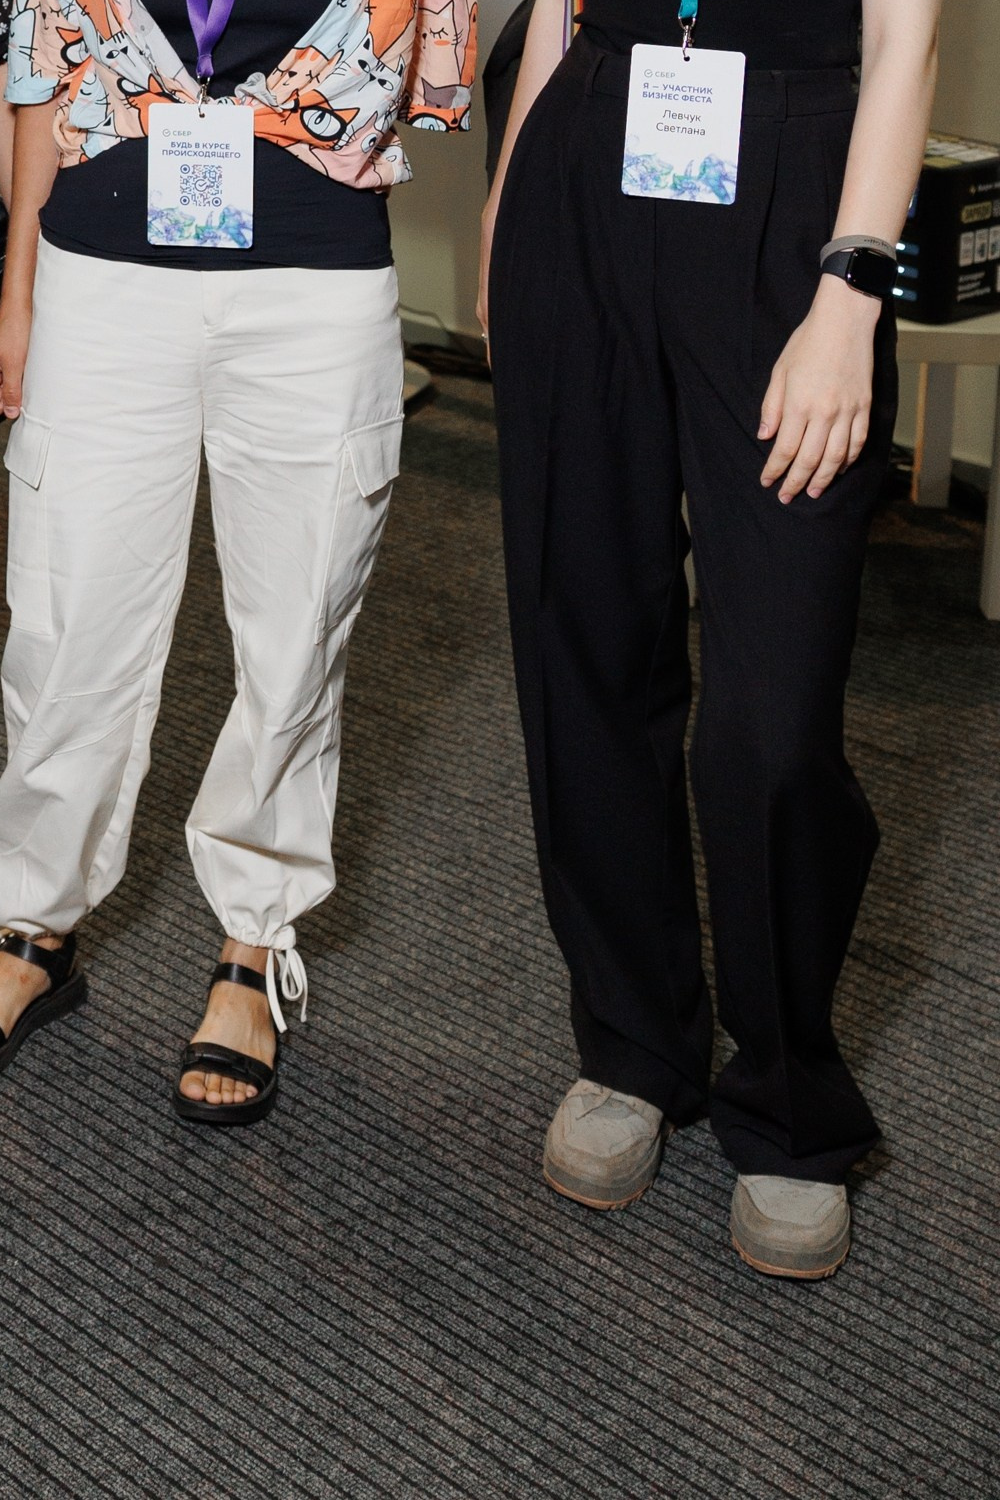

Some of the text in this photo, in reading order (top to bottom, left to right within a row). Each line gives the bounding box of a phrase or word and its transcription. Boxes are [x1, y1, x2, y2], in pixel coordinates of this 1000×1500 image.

[662, 84, 713, 95] УЧАСТНИК
[642, 92, 712, 104] БИЗНЕС ФЕСТА
[662, 110, 702, 123] Левчук
[656, 122, 706, 136] Светлана
[170, 141, 192, 149] БУДЬ
[162, 150, 241, 159] ПРОИСХОДЯЩЕГО
